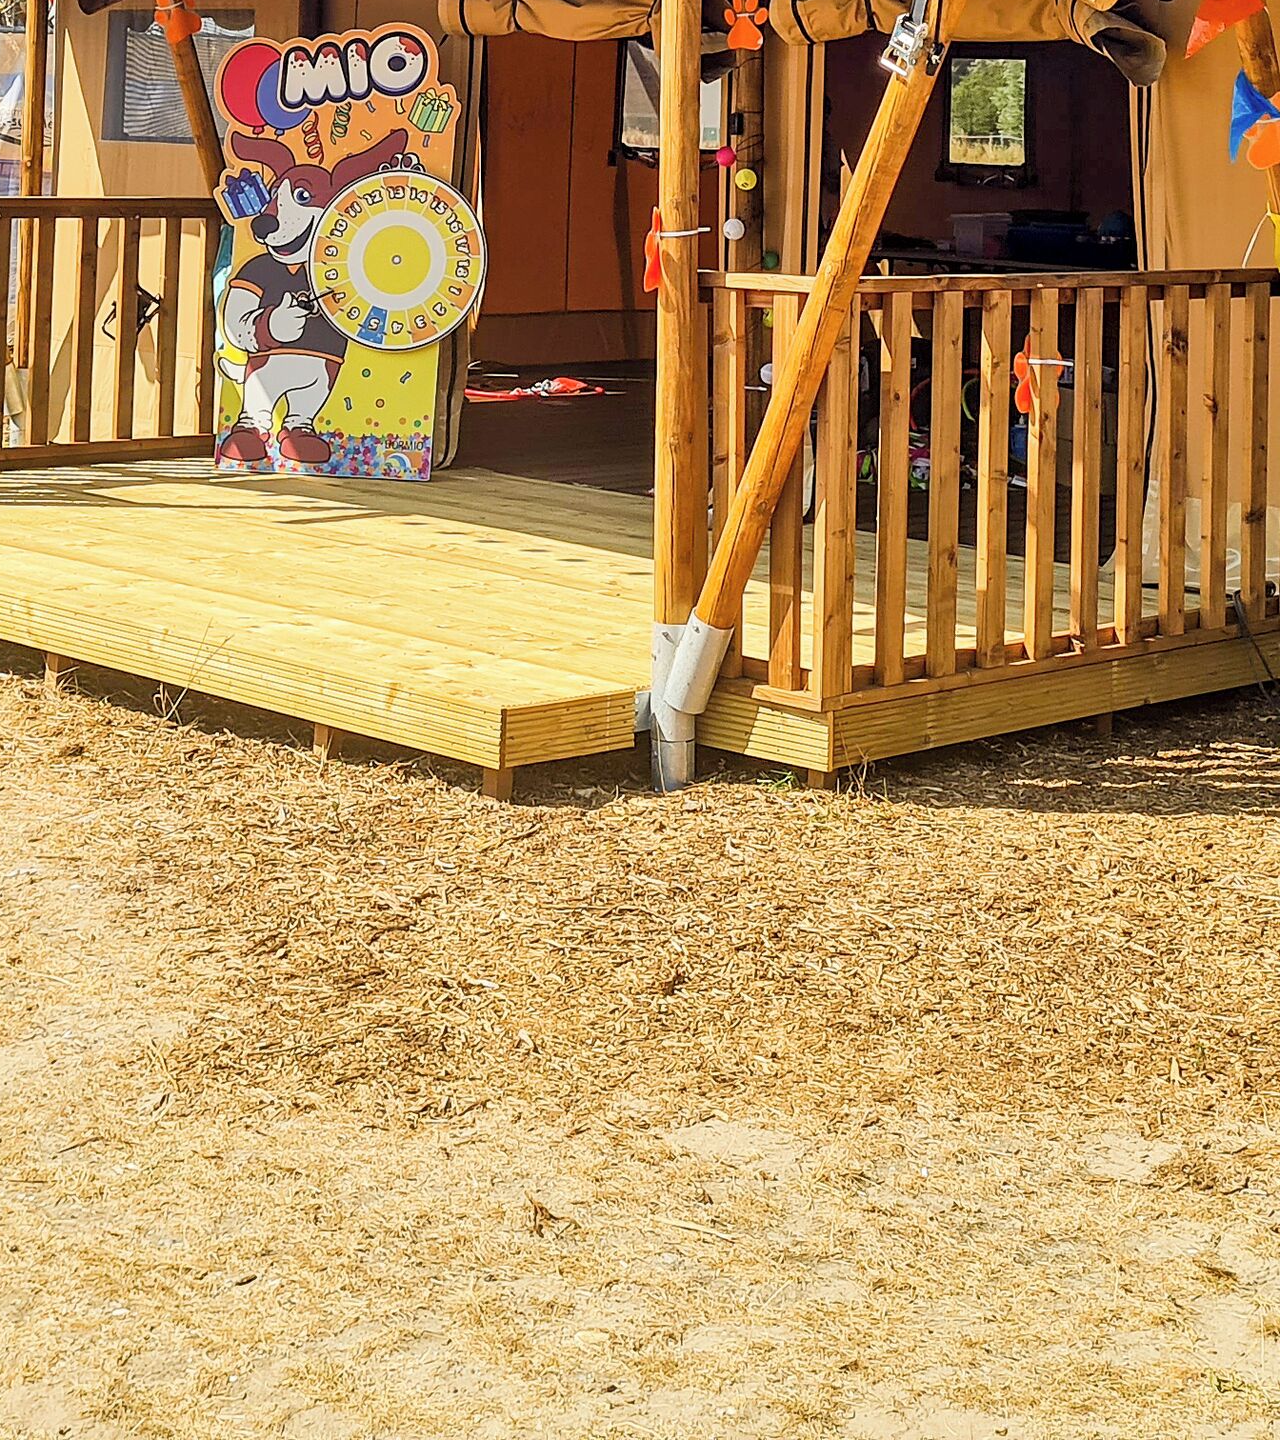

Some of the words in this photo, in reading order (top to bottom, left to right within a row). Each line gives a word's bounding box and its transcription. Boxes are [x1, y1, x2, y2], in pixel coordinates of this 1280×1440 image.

[281, 32, 427, 109] MIO
[363, 190, 383, 206] 12
[386, 186, 405, 199] 13
[410, 187, 428, 204] 14
[344, 201, 362, 218] 11
[430, 195, 449, 215] 15
[330, 219, 348, 237] 10
[446, 212, 463, 233] 16
[324, 245, 338, 257] 9
[455, 235, 470, 254] 17
[325, 268, 338, 280] 8
[455, 259, 470, 278] 18
[332, 292, 346, 304] 7
[448, 285, 462, 296] 1
[347, 306, 360, 320] 6
[432, 302, 447, 316] 2
[367, 317, 381, 331] 5
[391, 321, 404, 334] 4
[414, 314, 427, 329] 3
